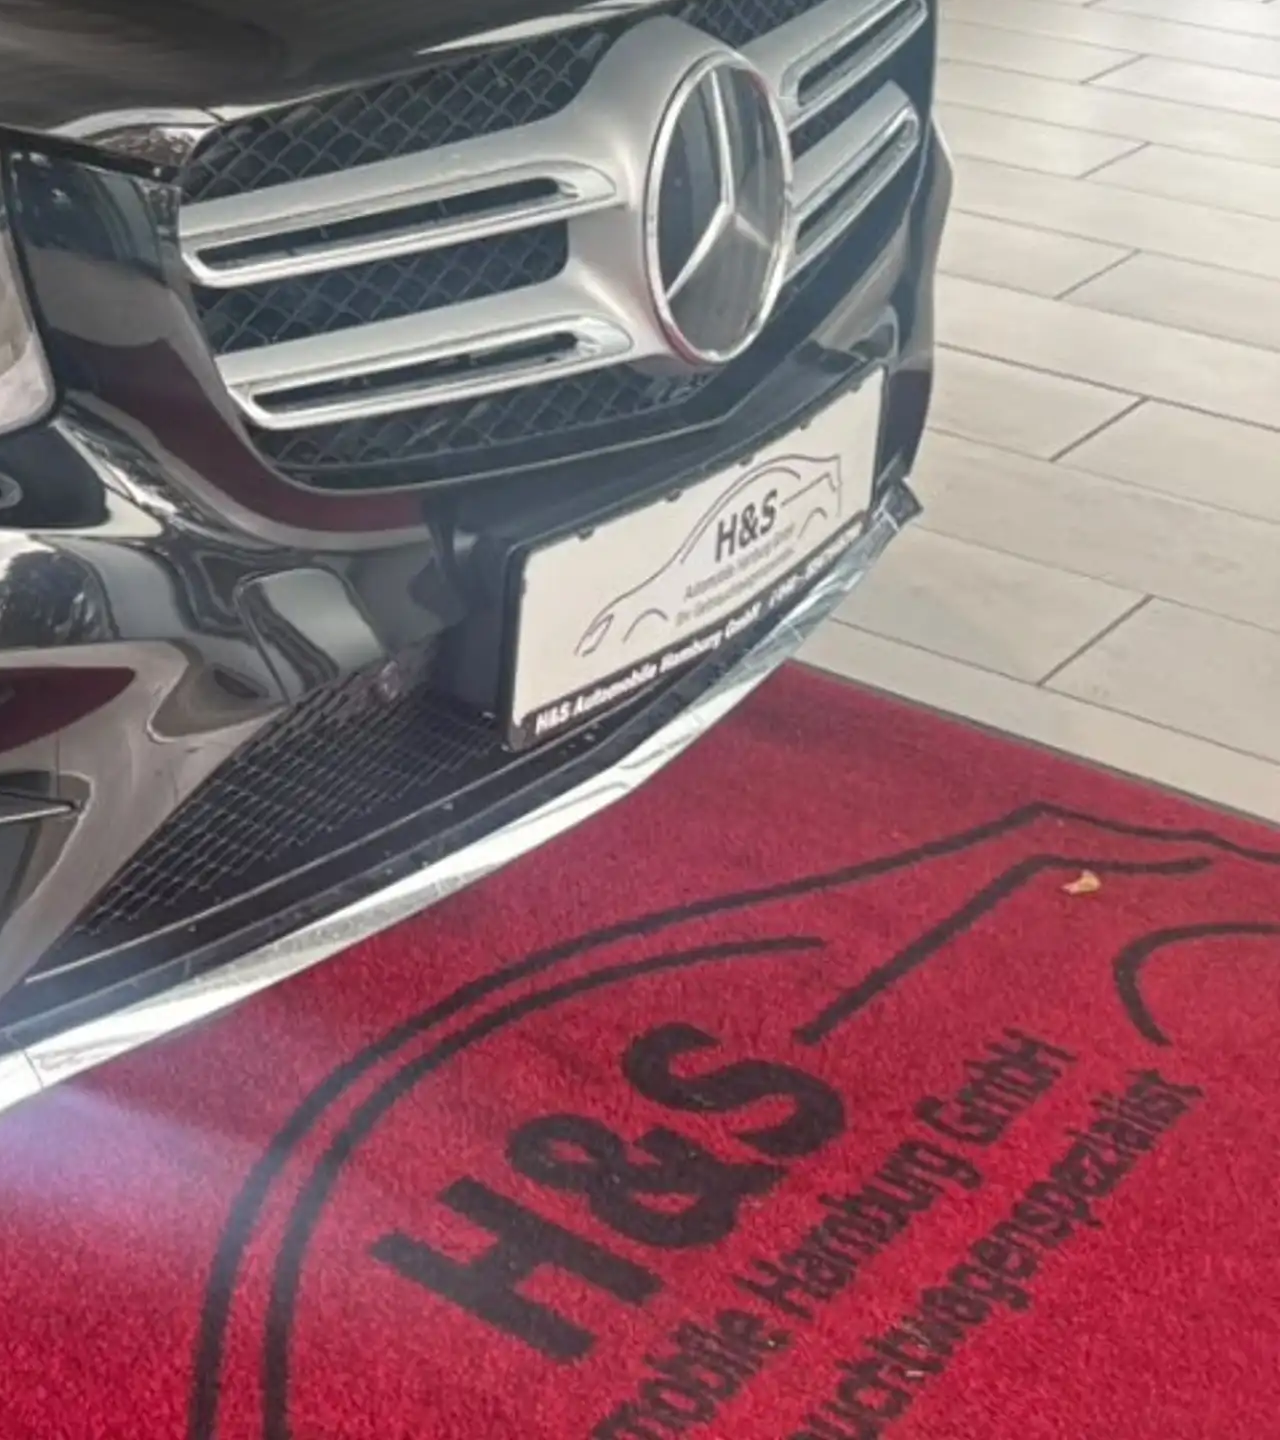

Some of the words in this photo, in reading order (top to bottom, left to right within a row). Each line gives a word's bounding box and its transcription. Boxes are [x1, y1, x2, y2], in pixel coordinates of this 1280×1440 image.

[714, 488, 778, 563] H&S
[369, 1021, 846, 1363] H&S
[733, 1139, 984, 1323] Hamburg
[913, 1027, 1078, 1147] GmbH
